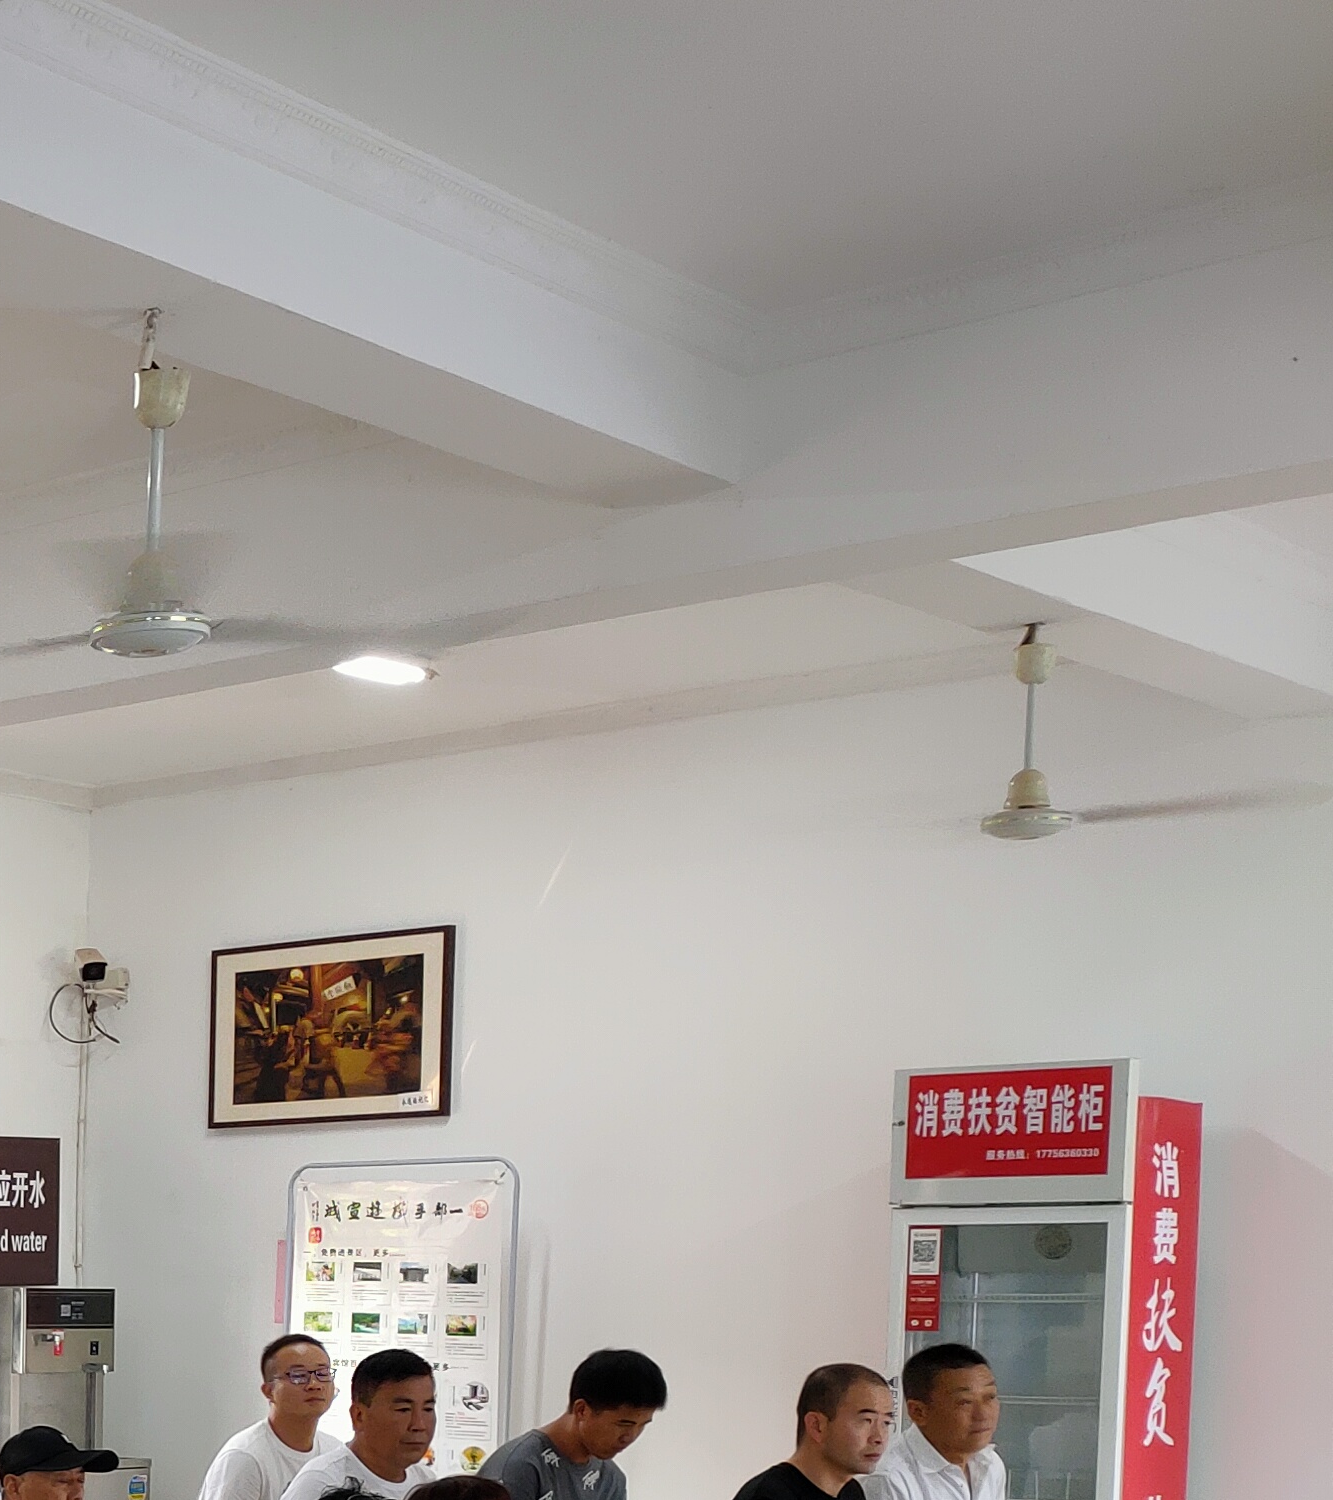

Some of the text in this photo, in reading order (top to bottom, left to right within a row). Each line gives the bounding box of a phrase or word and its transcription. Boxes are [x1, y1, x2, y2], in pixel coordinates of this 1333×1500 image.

[915, 1083, 1105, 1138] 消费扶贫智能柜
[11, 1231, 47, 1252] water
